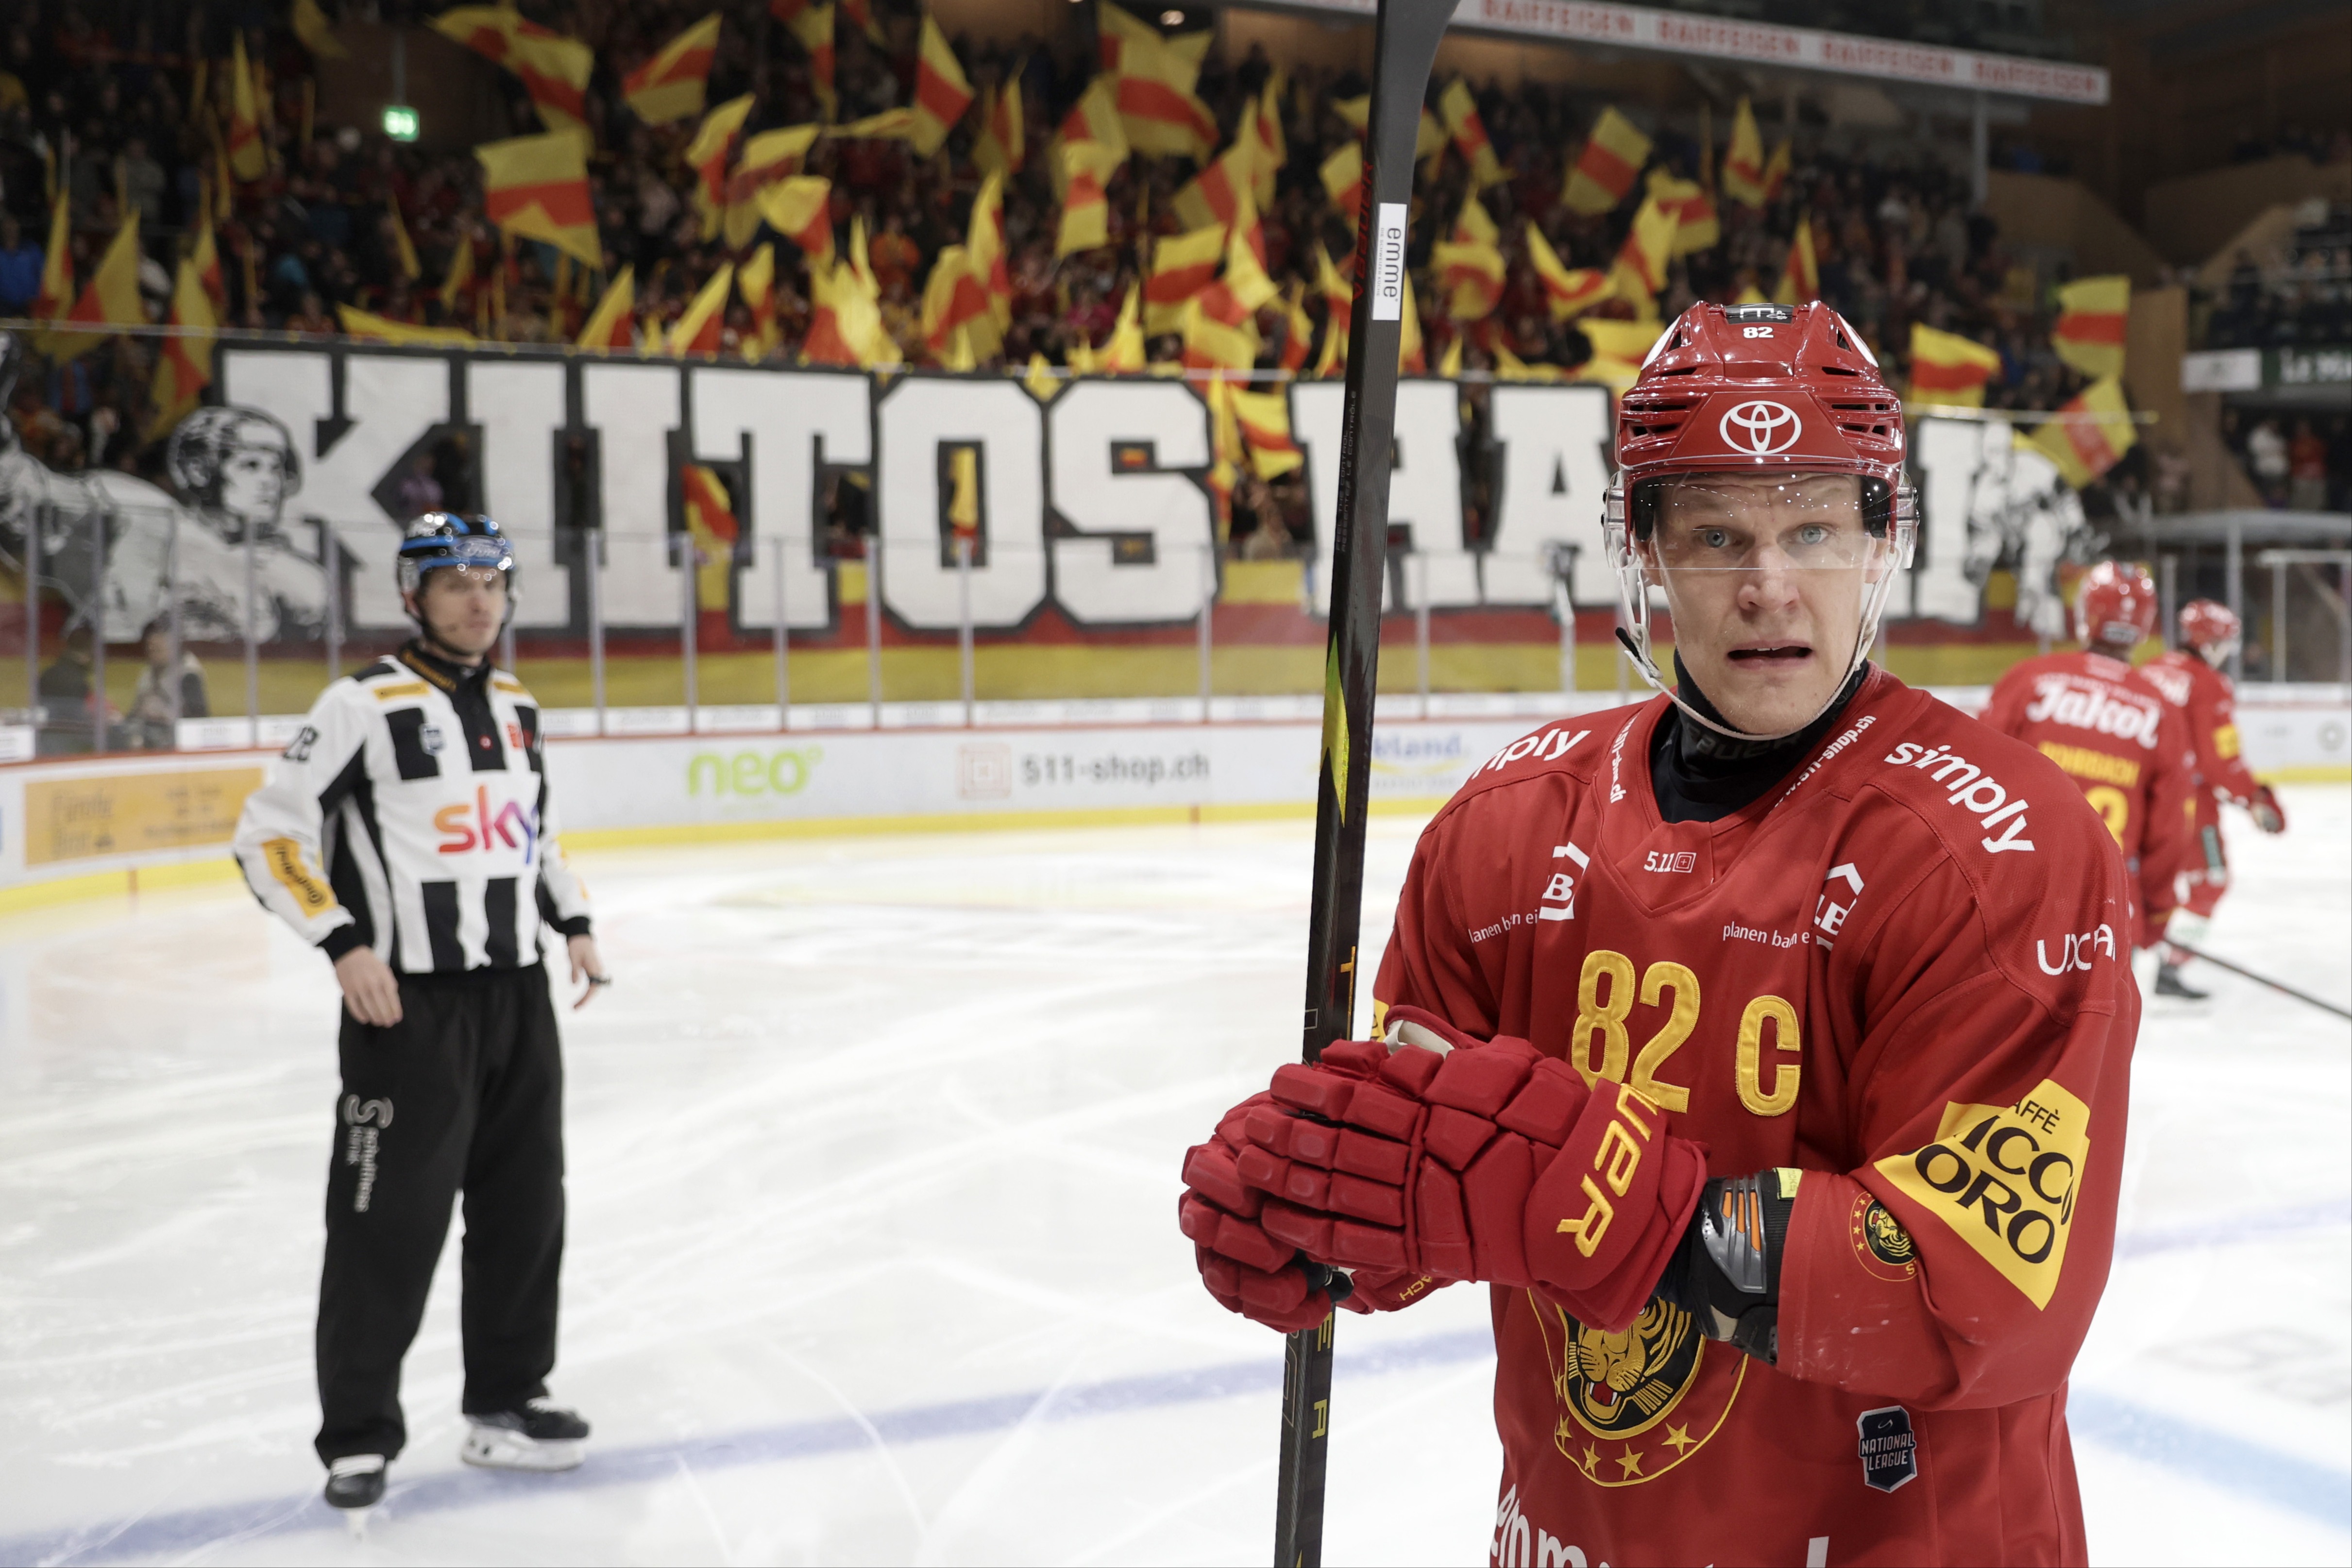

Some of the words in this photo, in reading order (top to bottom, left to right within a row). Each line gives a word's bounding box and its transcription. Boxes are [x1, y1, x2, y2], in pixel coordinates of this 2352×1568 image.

[1383, 227, 1402, 298] emme
[1742, 326, 1775, 339] 82
[225, 352, 1215, 627] KIITOS
[1021, 751, 1210, 788] 511-shop.ch
[1883, 742, 2036, 854] simply
[433, 783, 539, 866] sky
[1643, 850, 1675, 873] 5.11
[1468, 923, 1502, 944] lanen
[1723, 920, 1768, 944] planen
[1571, 949, 1700, 1114] 82
[1735, 995, 1801, 1116] C
[2012, 1099, 2060, 1135] AFFÈ
[1861, 1432, 1914, 1455] NATIONAL
[1868, 1449, 1909, 1471] LEAGUE
